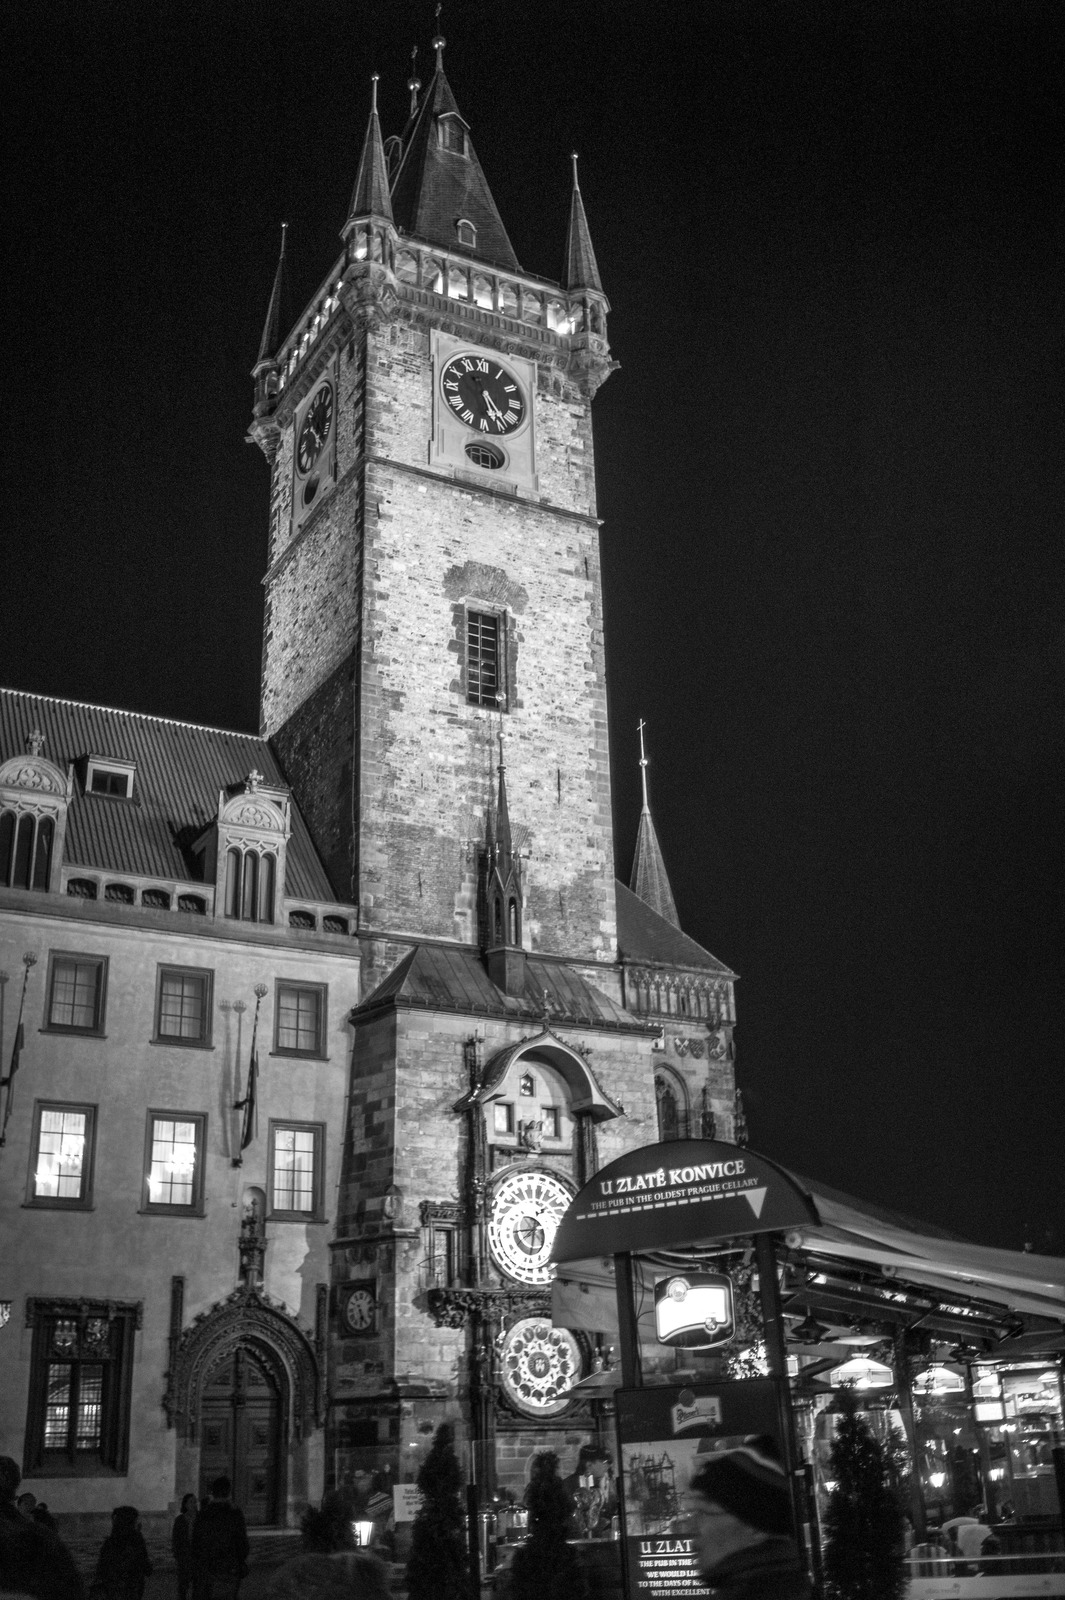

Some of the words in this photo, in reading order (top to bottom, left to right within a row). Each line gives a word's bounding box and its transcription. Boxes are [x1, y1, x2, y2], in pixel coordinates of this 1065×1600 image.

[449, 366, 463, 378] X
[476, 360, 489, 373] XII
[504, 384, 517, 393] II
[616, 1167, 667, 1193] ZLATÉ
[669, 1160, 746, 1185] KONVICE
[591, 1201, 607, 1210] THE
[608, 1198, 624, 1207] PUB
[625, 1196, 635, 1205] IN
[636, 1194, 653, 1203] THE
[654, 1189, 686, 1201] OLDEST
[687, 1184, 721, 1196] PRAGUE
[721, 1178, 758, 1190] CELLARY
[656, 1539, 693, 1553] ZLAT
[678, 1558, 693, 1566] THE
